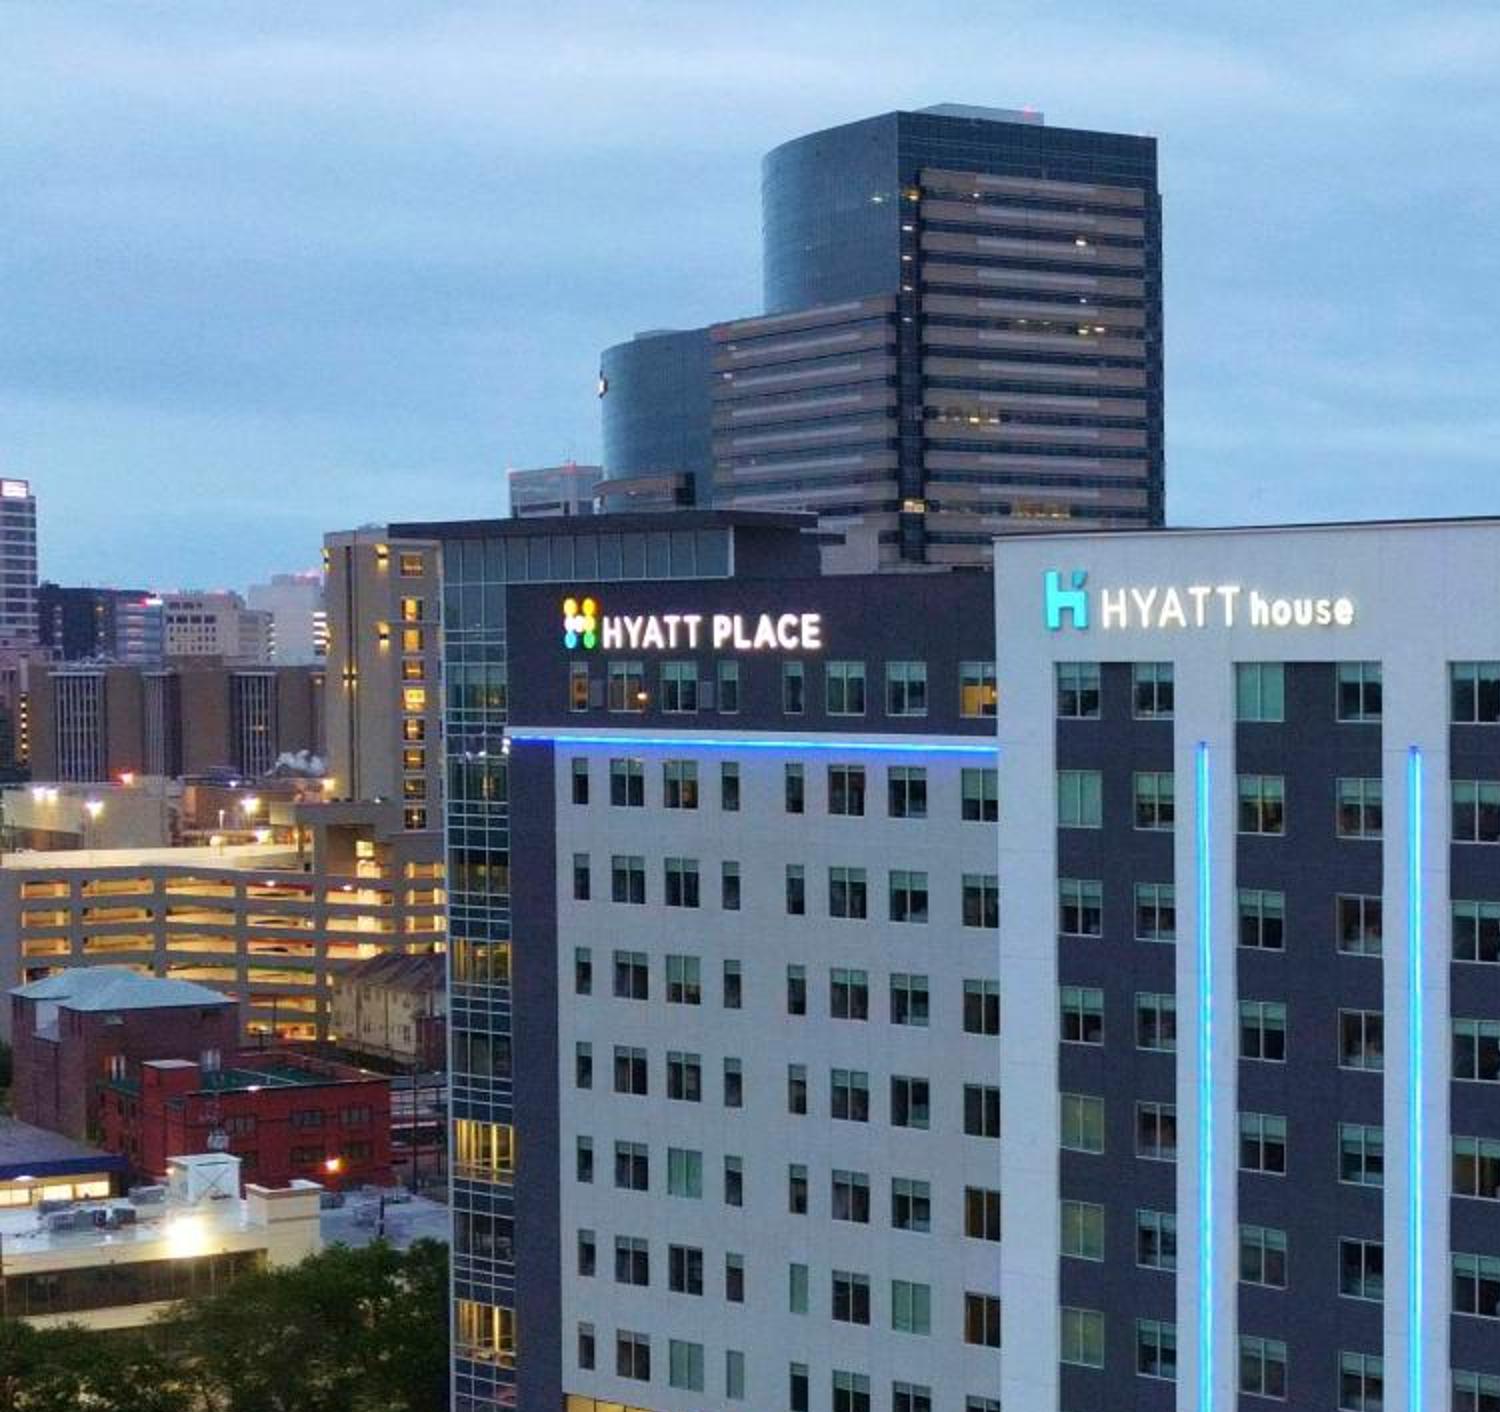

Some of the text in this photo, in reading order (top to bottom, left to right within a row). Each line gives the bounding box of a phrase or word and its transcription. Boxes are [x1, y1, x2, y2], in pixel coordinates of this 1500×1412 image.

[1102, 586, 1354, 628] HYATT house
[603, 613, 822, 649] HYATT PLACE
